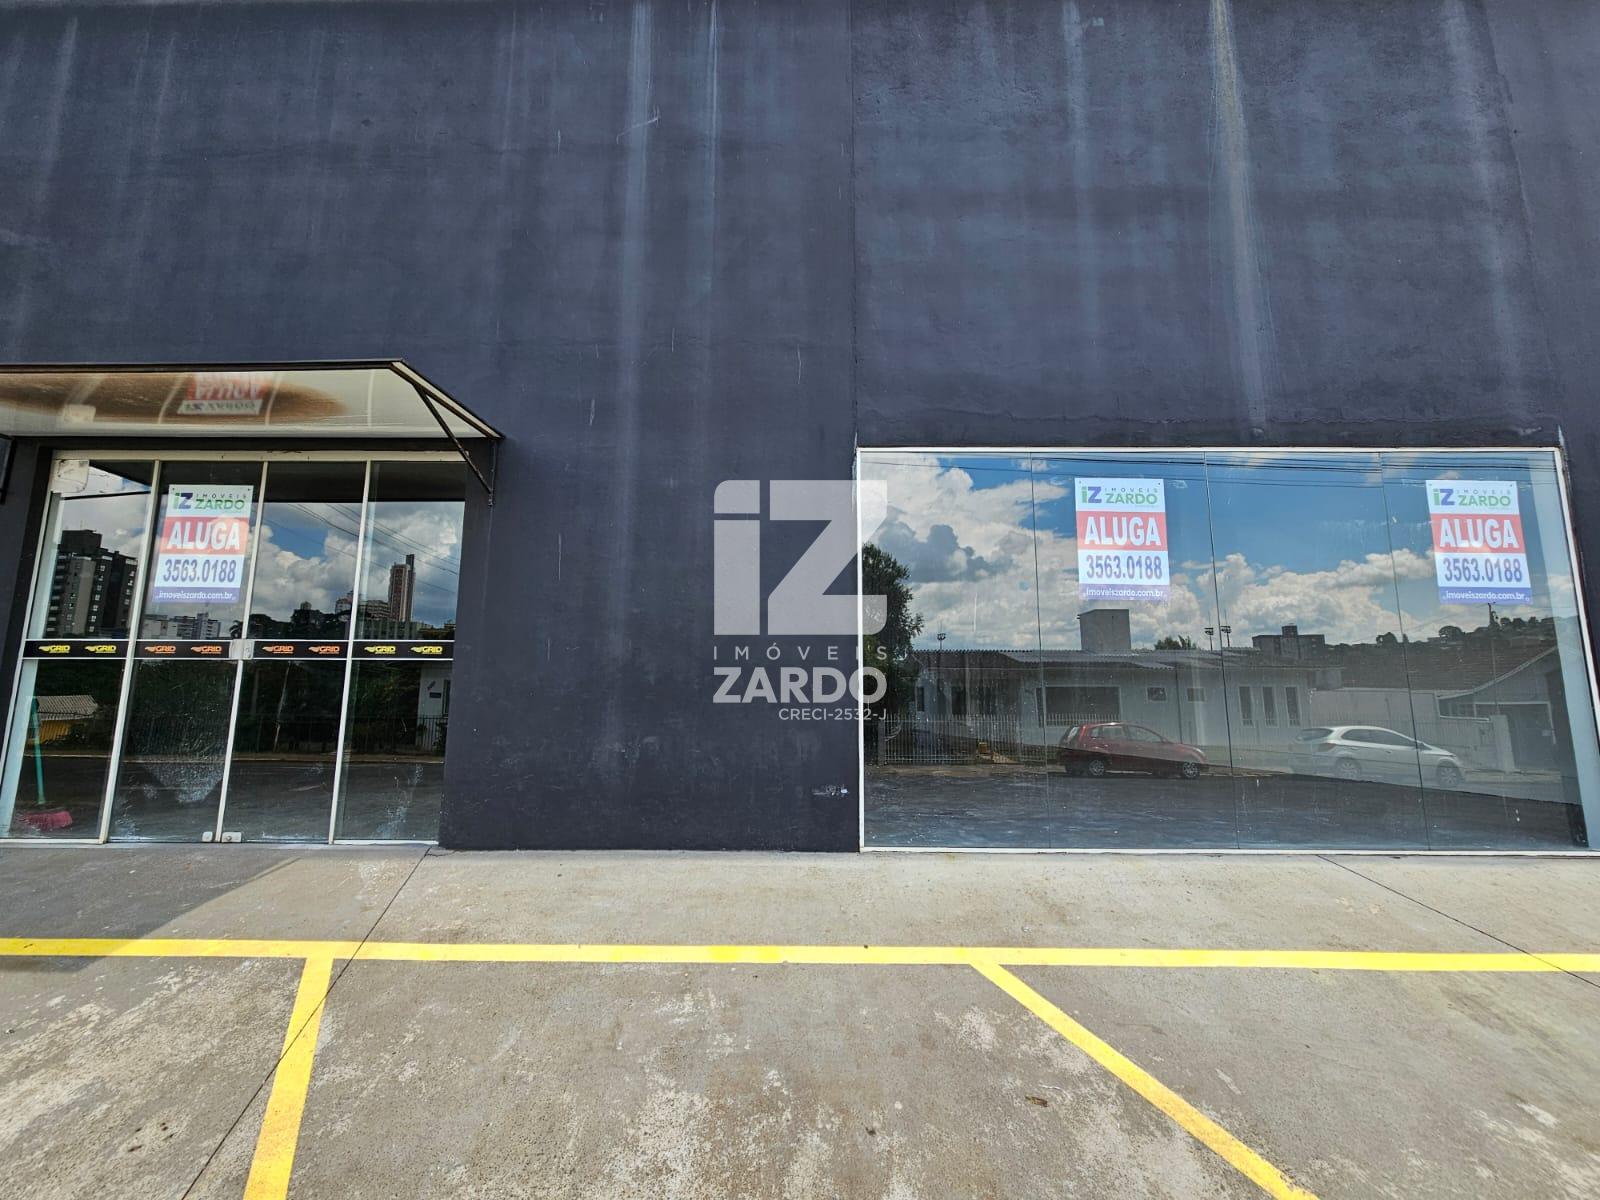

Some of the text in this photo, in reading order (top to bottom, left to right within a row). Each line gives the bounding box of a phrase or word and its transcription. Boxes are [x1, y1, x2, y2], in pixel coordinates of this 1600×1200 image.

[194, 499, 245, 510] ZARDO
[1105, 493, 1158, 505] ZARDO
[1457, 495, 1511, 507] ZARDO
[166, 521, 240, 550] ALUGA
[1084, 516, 1161, 546] ALUGA
[1439, 518, 1519, 549] ALUGA
[163, 559, 237, 583] 3563.0188
[1086, 554, 1162, 580] 3563.0188
[1443, 557, 1523, 583] 3563.0188
[158, 590, 233, 601] imoveiszardo.com.br
[1086, 588, 1164, 598] imoveiszardo.com.br
[1445, 590, 1525, 601] imoveiszardo.com.br
